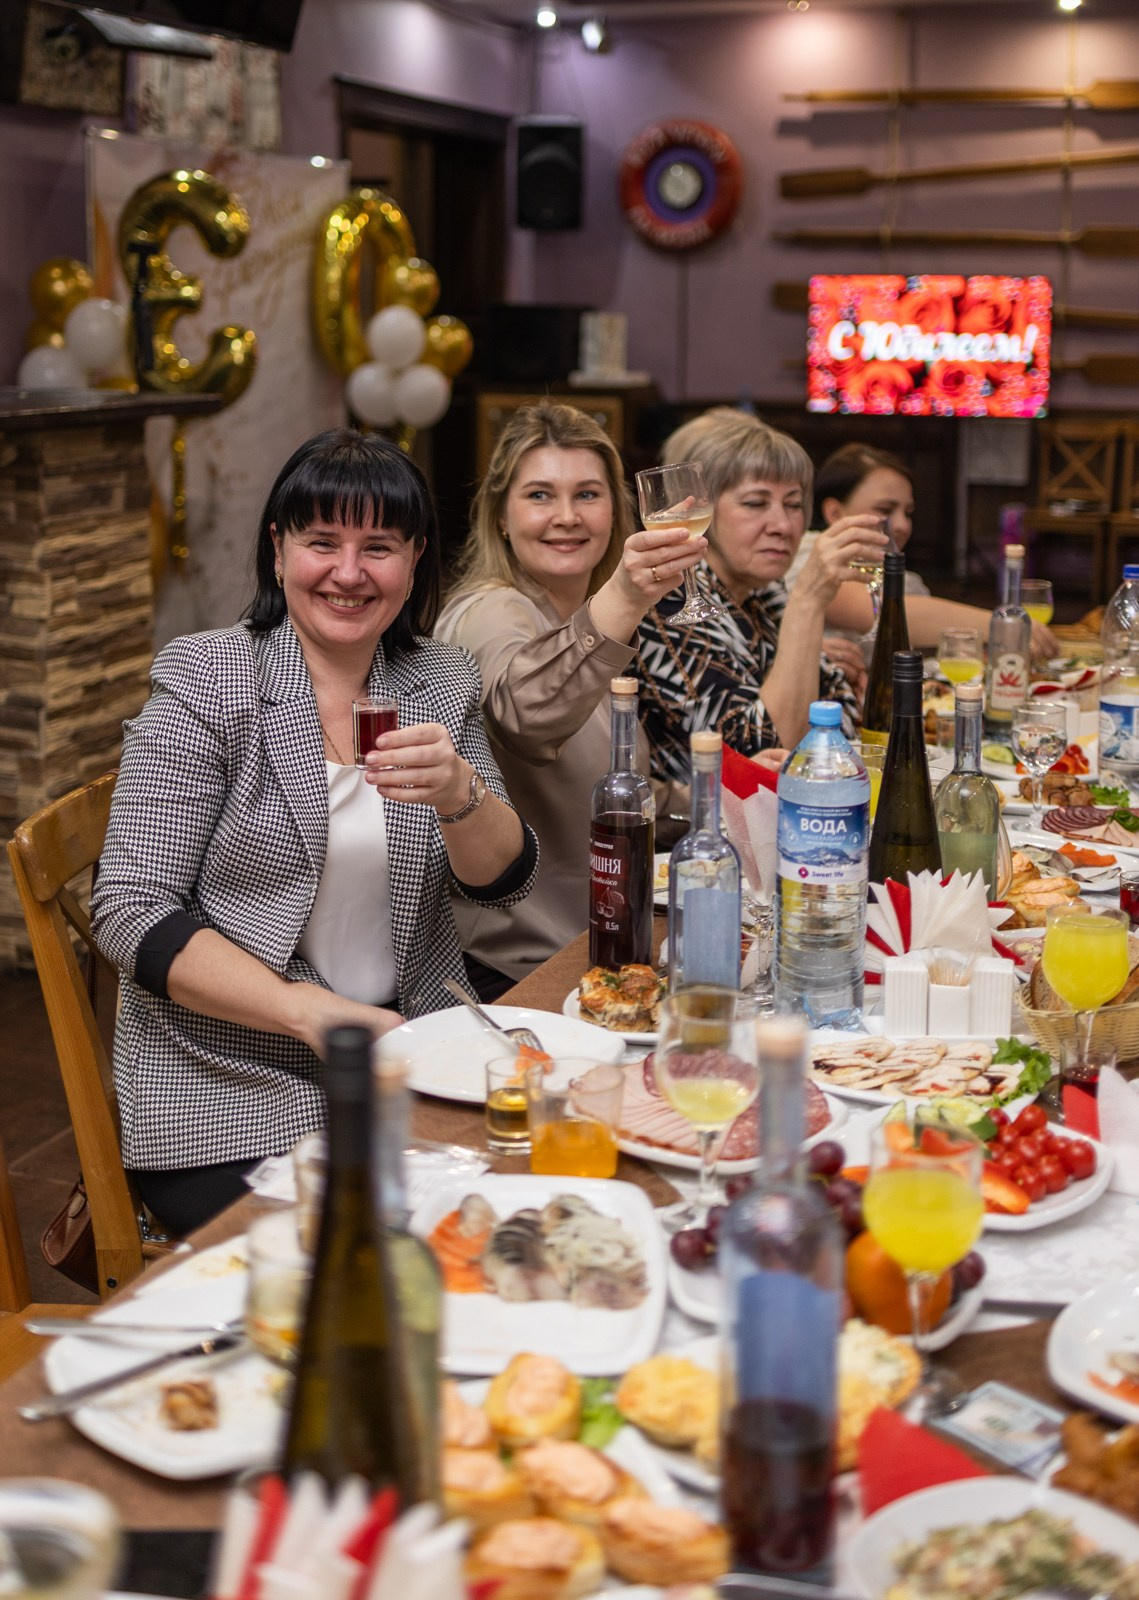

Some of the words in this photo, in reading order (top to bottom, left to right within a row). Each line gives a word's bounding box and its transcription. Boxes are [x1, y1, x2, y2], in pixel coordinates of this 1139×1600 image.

[827, 320, 857, 361] С
[800, 818, 847, 836] ВОДА
[590, 854, 622, 875] ИШНЯ
